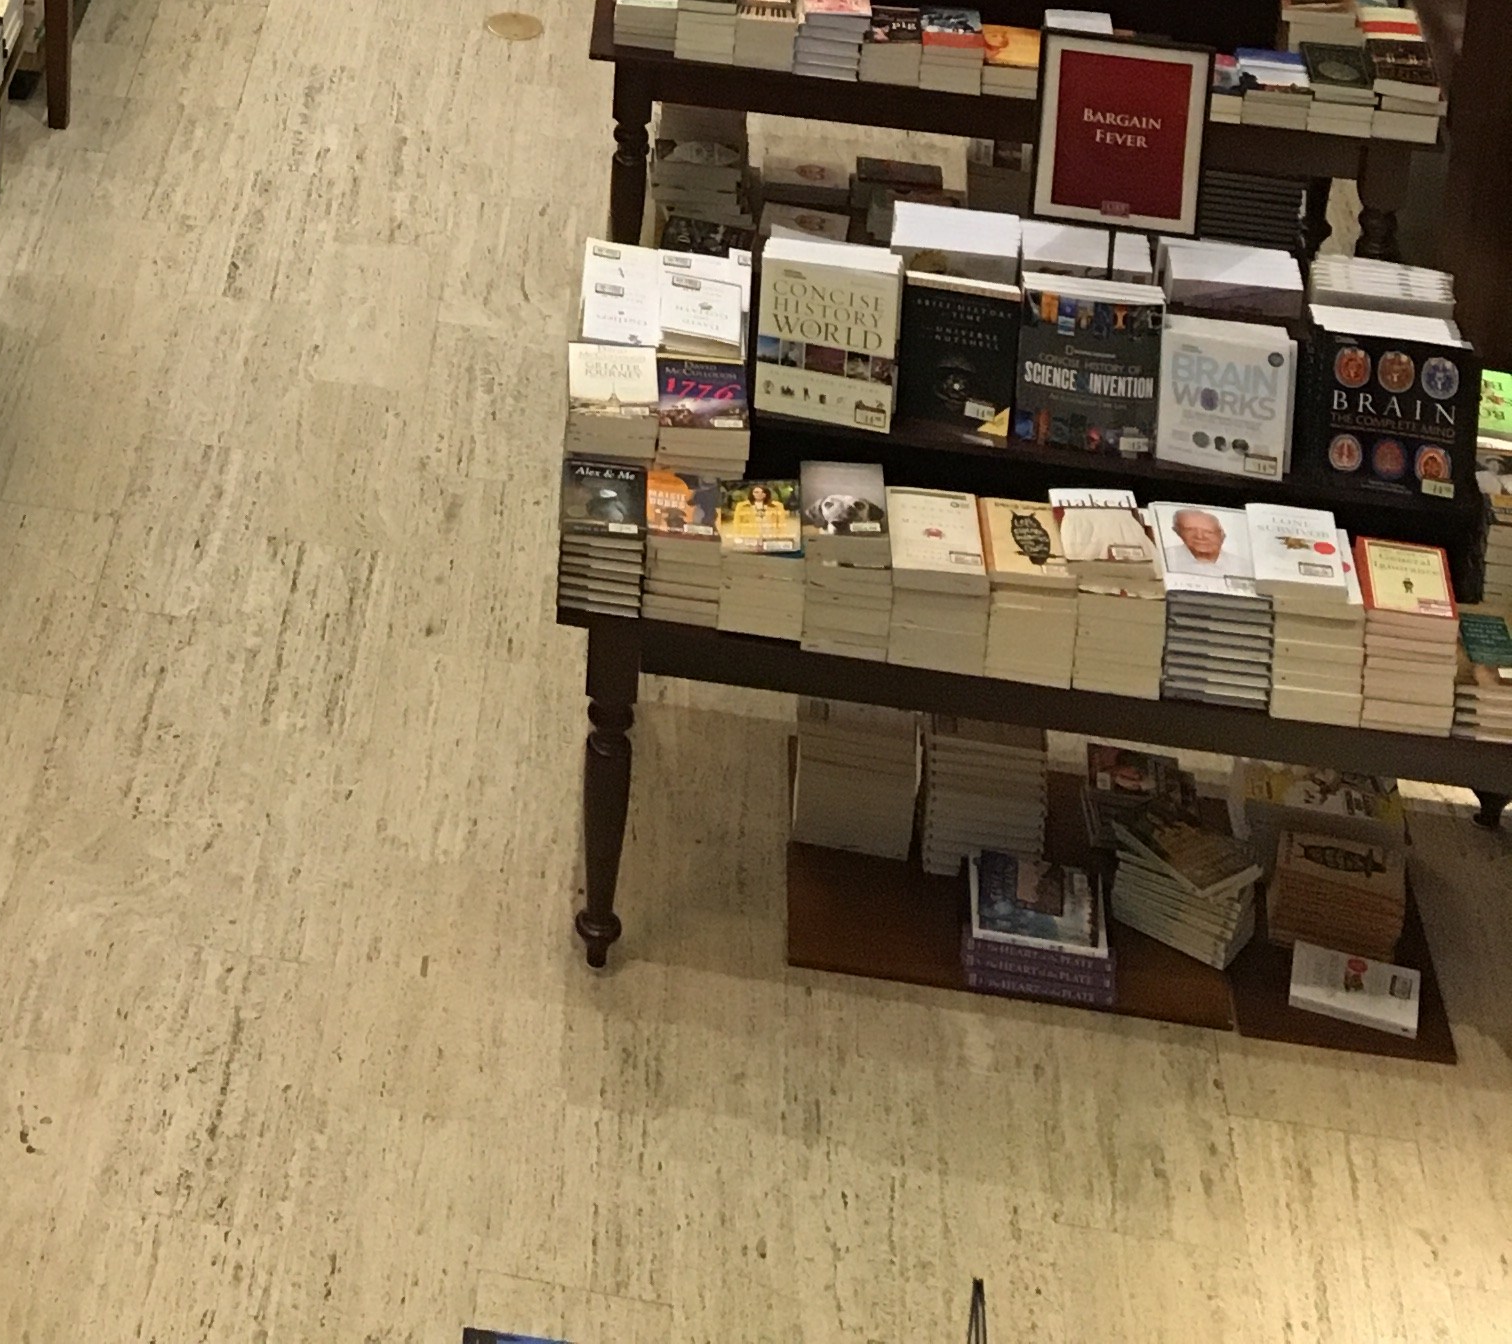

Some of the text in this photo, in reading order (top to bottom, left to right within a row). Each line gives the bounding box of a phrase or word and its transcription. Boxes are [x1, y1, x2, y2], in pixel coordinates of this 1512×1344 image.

[1082, 107, 1162, 131] BARGAIN
[1095, 128, 1148, 149] FEVER
[773, 280, 886, 311] CONCISE
[774, 296, 882, 329] HISTORY
[772, 313, 883, 351] WORLD
[1024, 361, 1154, 399] SCIENCE INVENTION
[1171, 352, 1278, 397] BRAIN
[666, 377, 741, 401] 1776
[1332, 389, 1456, 425] BRAIN
[1330, 412, 1352, 424] THE
[1355, 414, 1417, 431] COMPLETE
[575, 466, 636, 481] Alex & Me
[1058, 493, 1132, 508] naked
